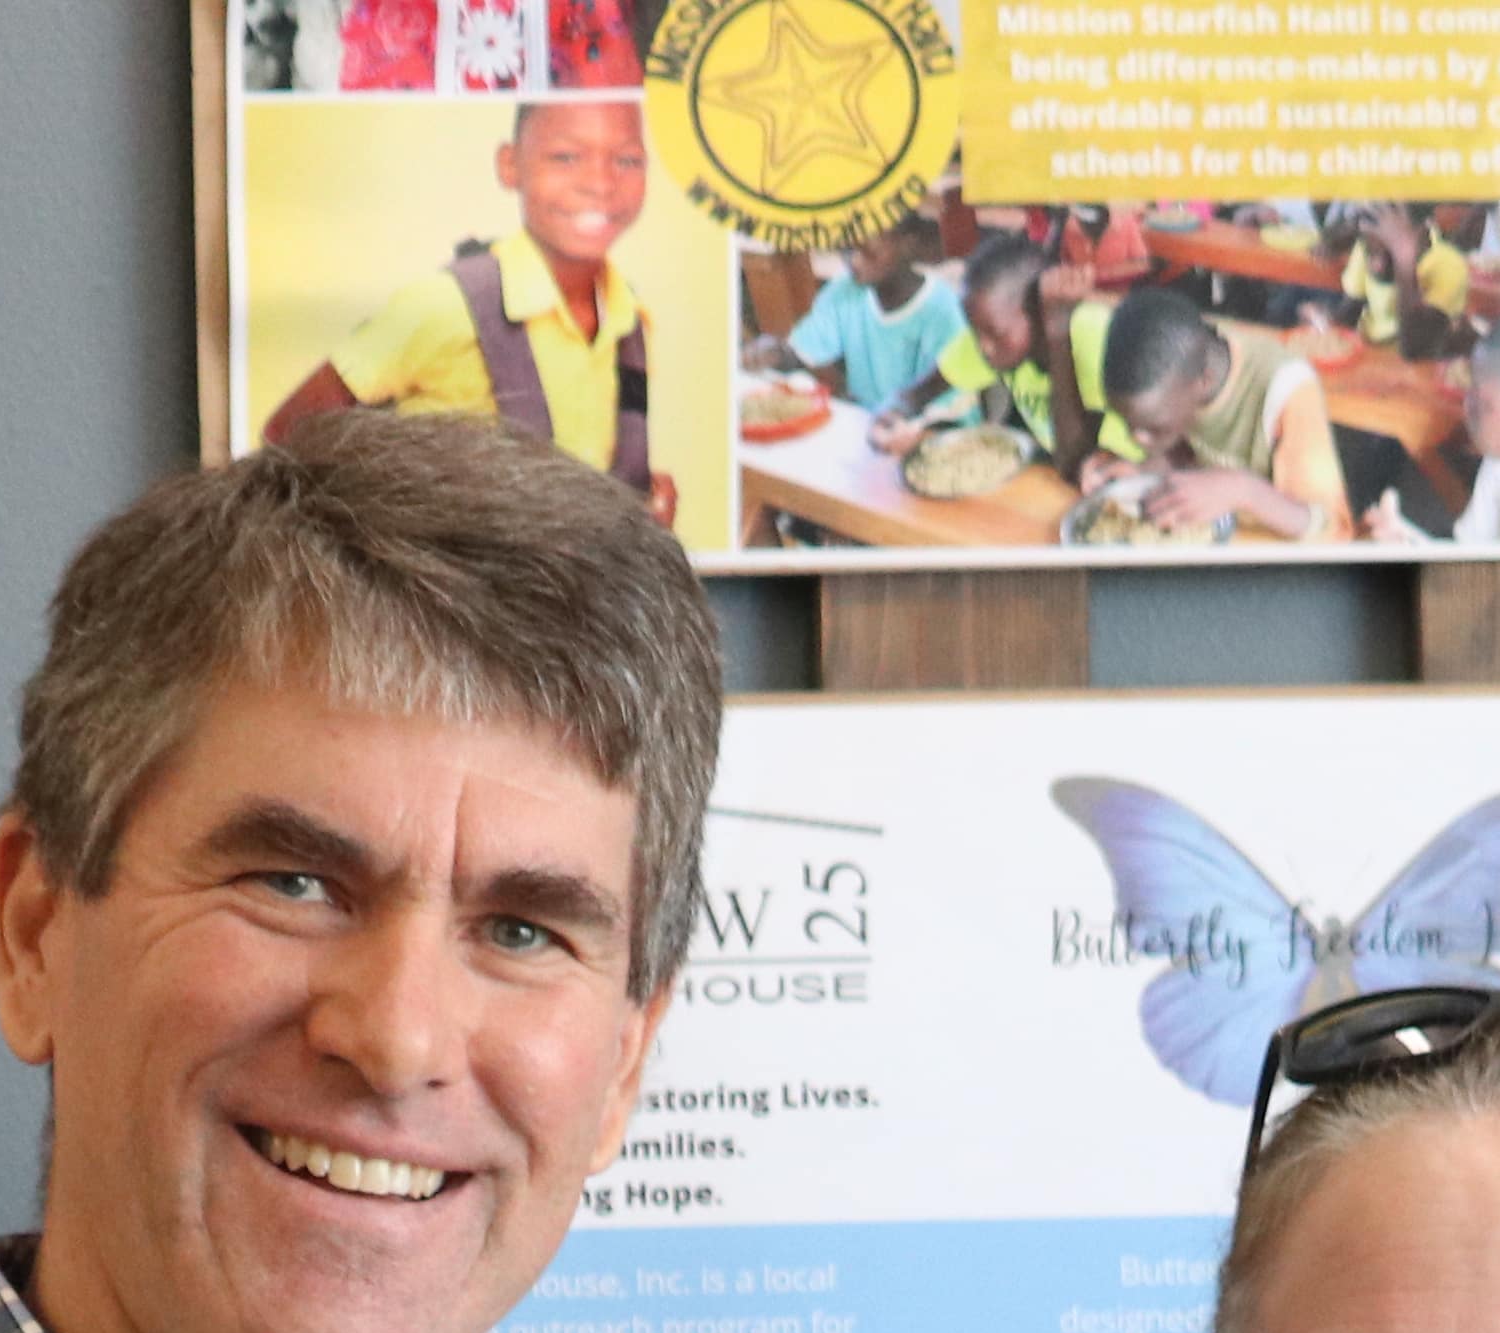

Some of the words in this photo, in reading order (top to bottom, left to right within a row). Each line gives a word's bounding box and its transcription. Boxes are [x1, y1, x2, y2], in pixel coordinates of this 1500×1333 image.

[997, 4, 1133, 36] Mission
[1141, 4, 1280, 35] Starfish
[1287, 4, 1372, 34] Haiti
[1380, 4, 1410, 35] is
[1010, 51, 1110, 90] being
[1446, 51, 1490, 89] by
[1010, 99, 1194, 131] affordable
[1202, 99, 1269, 130] and
[1277, 99, 1479, 130] sustainable
[1051, 146, 1183, 178] schools
[1191, 146, 1241, 177] for
[1251, 146, 1310, 177] the
[1318, 146, 1462, 177] children
[1051, 906, 1249, 990] Butterfly
[1270, 904, 1446, 970] Freedom
[640, 1083, 770, 1119] storing
[781, 1082, 880, 1109] Lives.
[625, 1180, 723, 1213] Hope.
